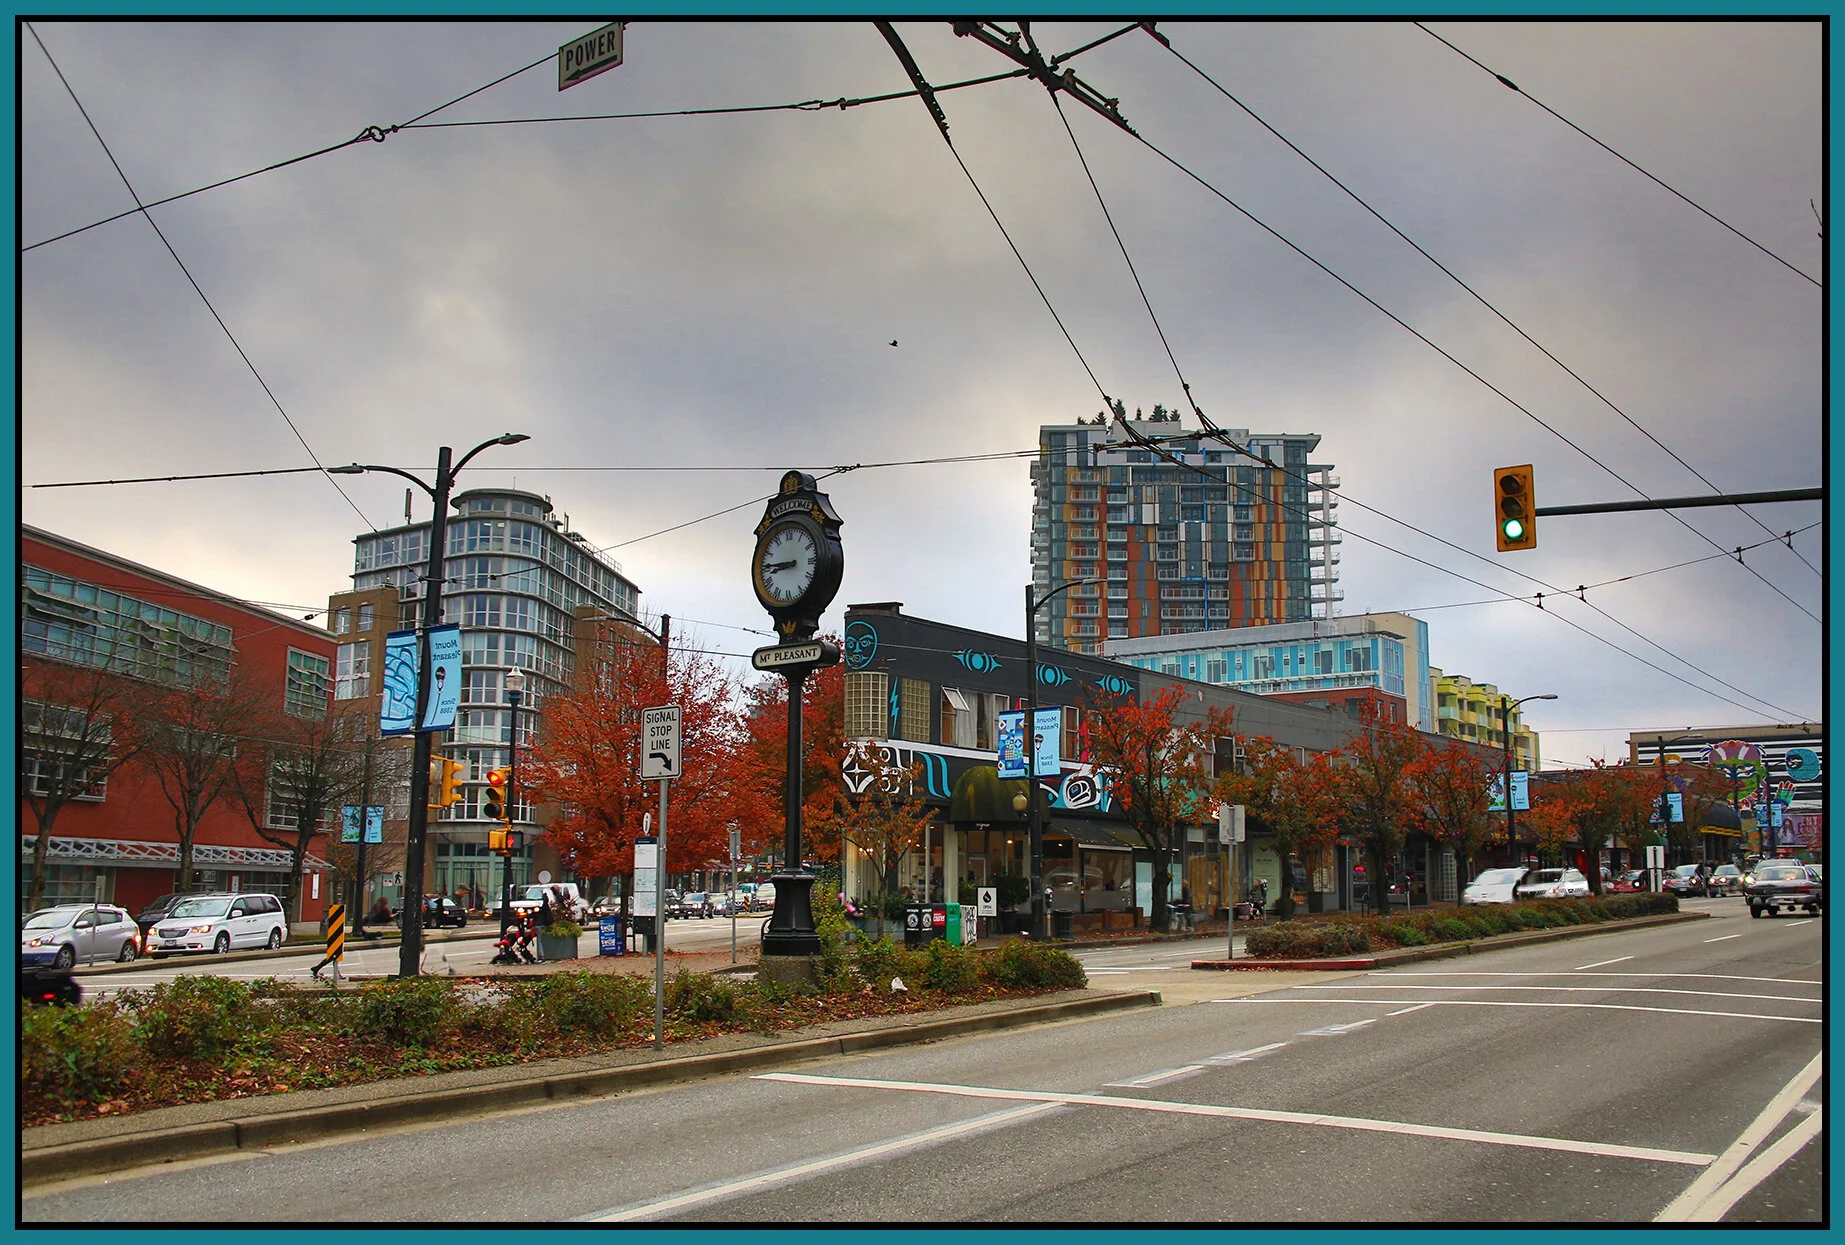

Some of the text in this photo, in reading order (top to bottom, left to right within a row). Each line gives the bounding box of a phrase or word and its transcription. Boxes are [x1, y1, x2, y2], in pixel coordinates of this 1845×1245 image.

[566, 31, 615, 71] POWER
[773, 500, 811, 516] WELCOME
[774, 648, 818, 661] PLEASANT
[646, 711, 677, 724] SIGNAL
[650, 725, 672, 737] STOP
[651, 739, 670, 751] LINE
